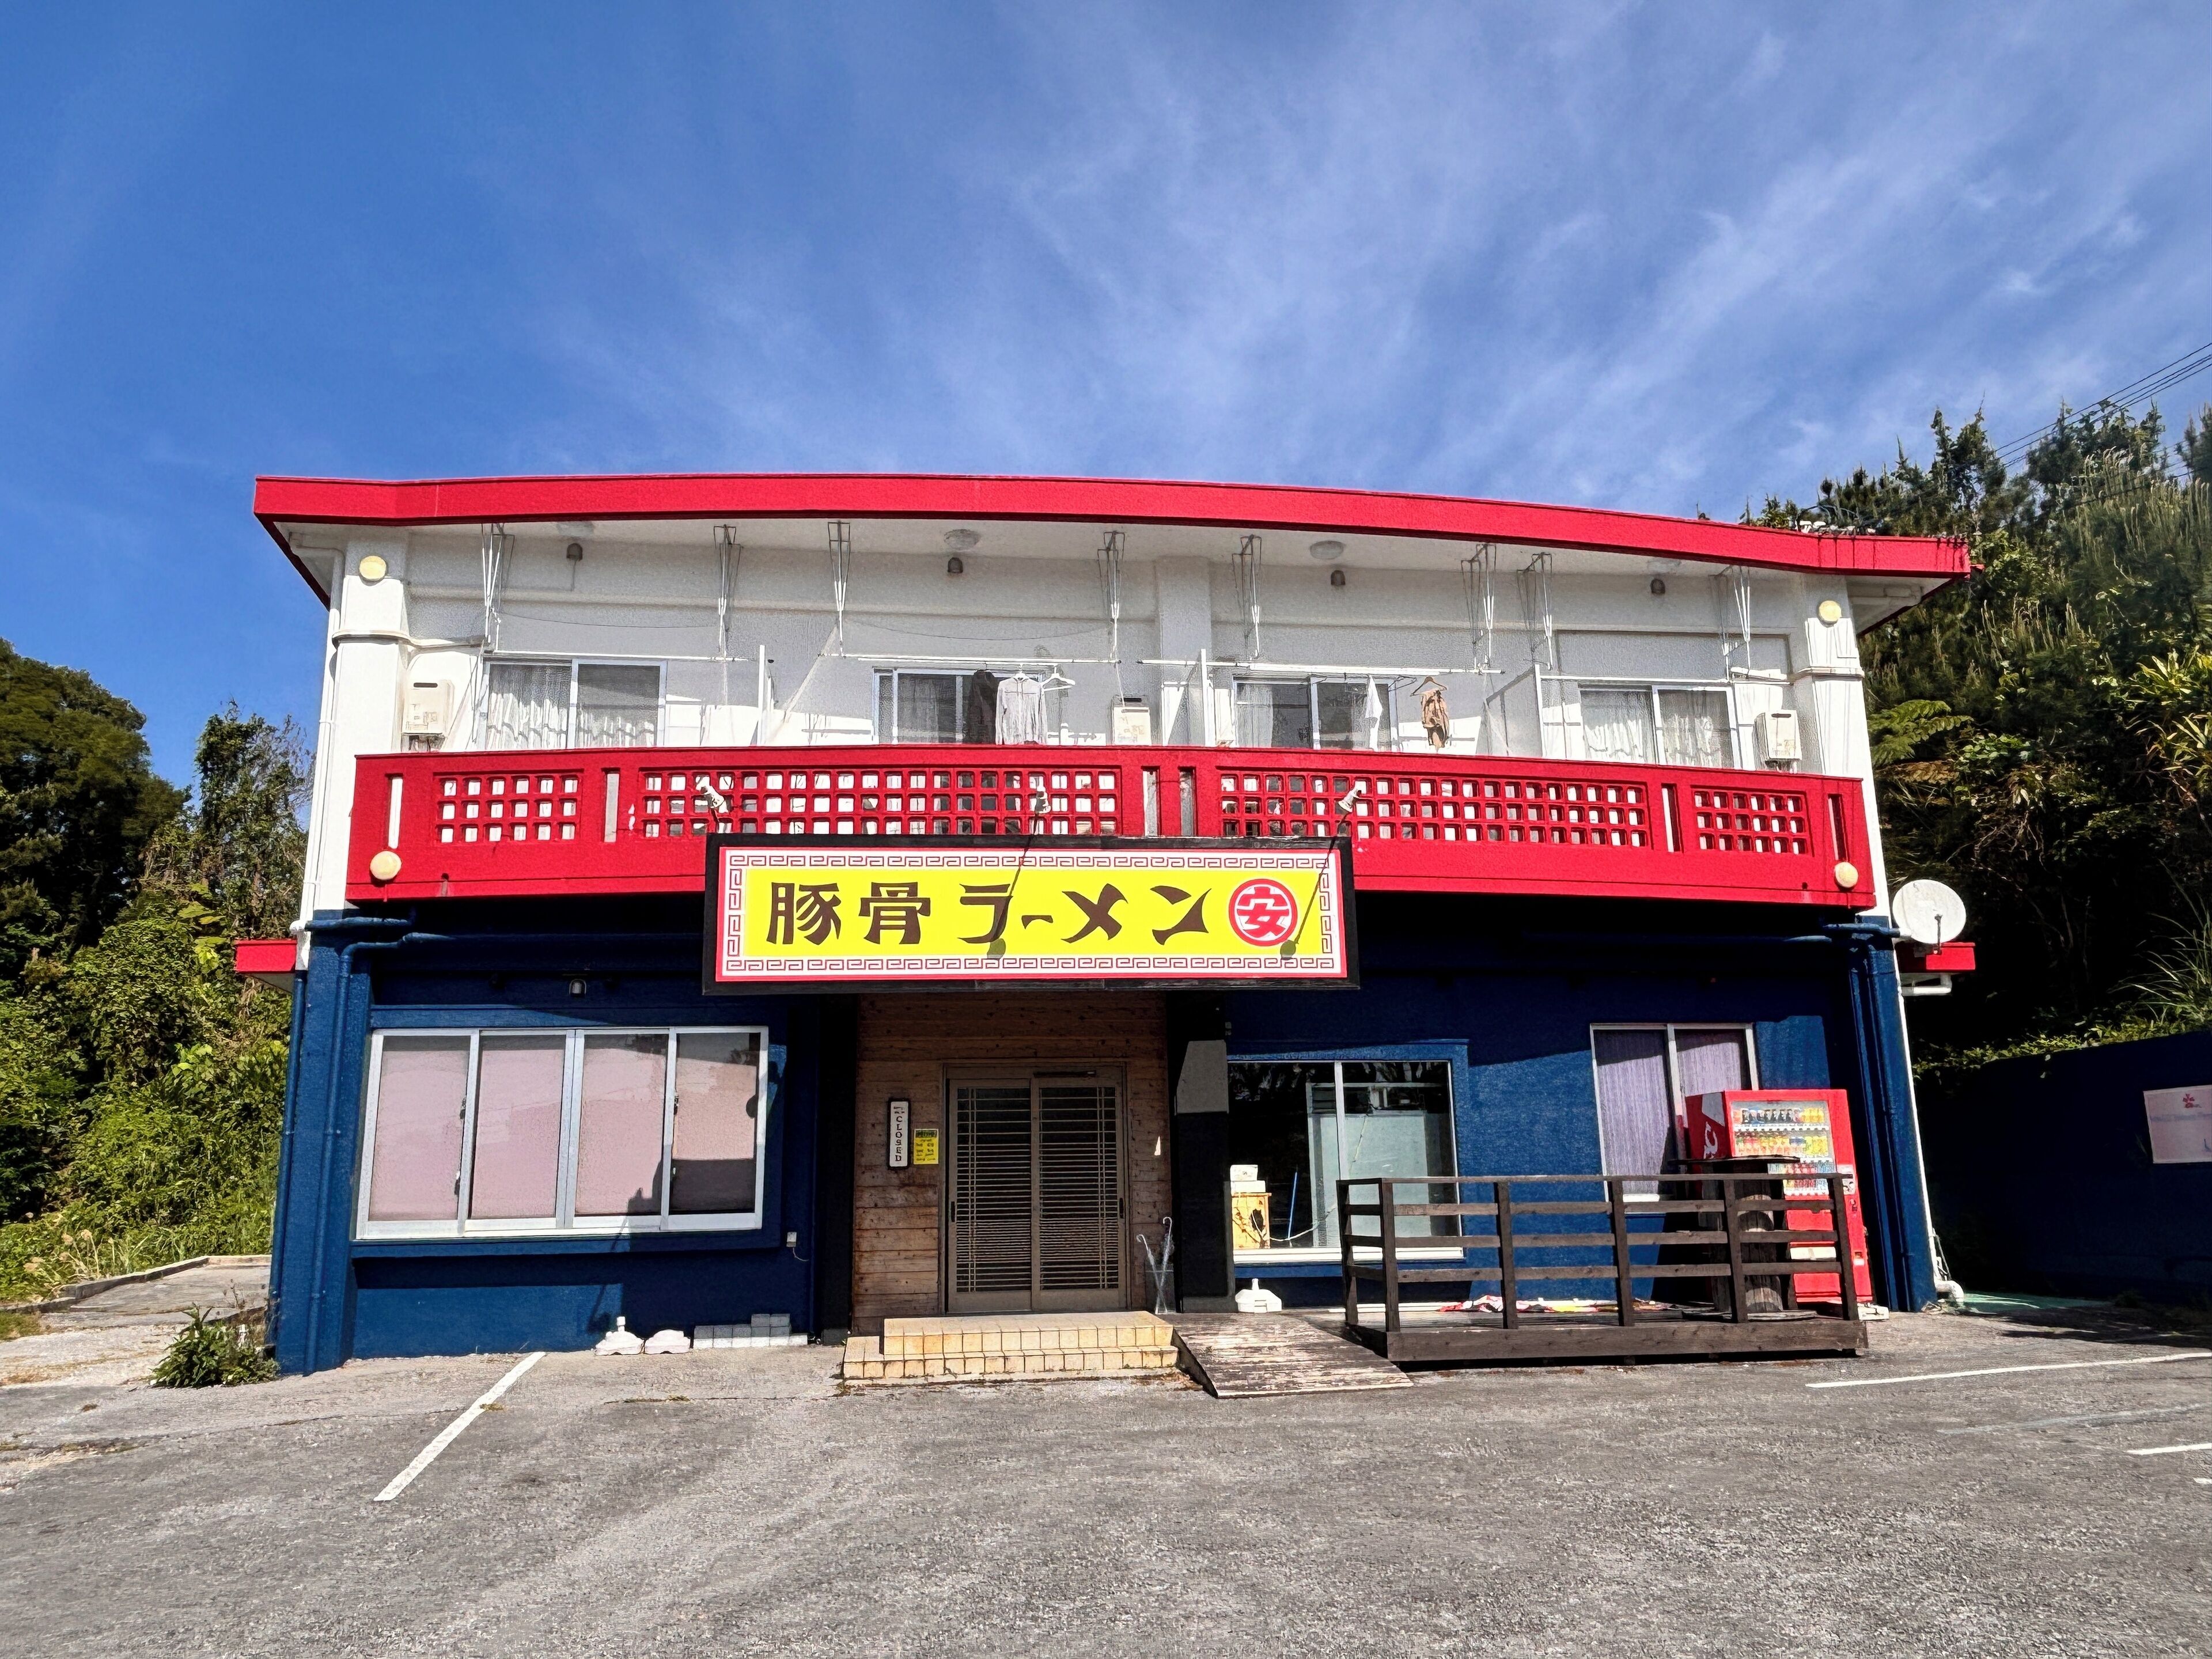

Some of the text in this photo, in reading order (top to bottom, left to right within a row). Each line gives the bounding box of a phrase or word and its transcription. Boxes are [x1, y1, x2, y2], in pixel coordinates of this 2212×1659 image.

[766, 881, 1290, 945] 豚骨ラーメン 安
[895, 1115, 903, 1162] CLOSED
